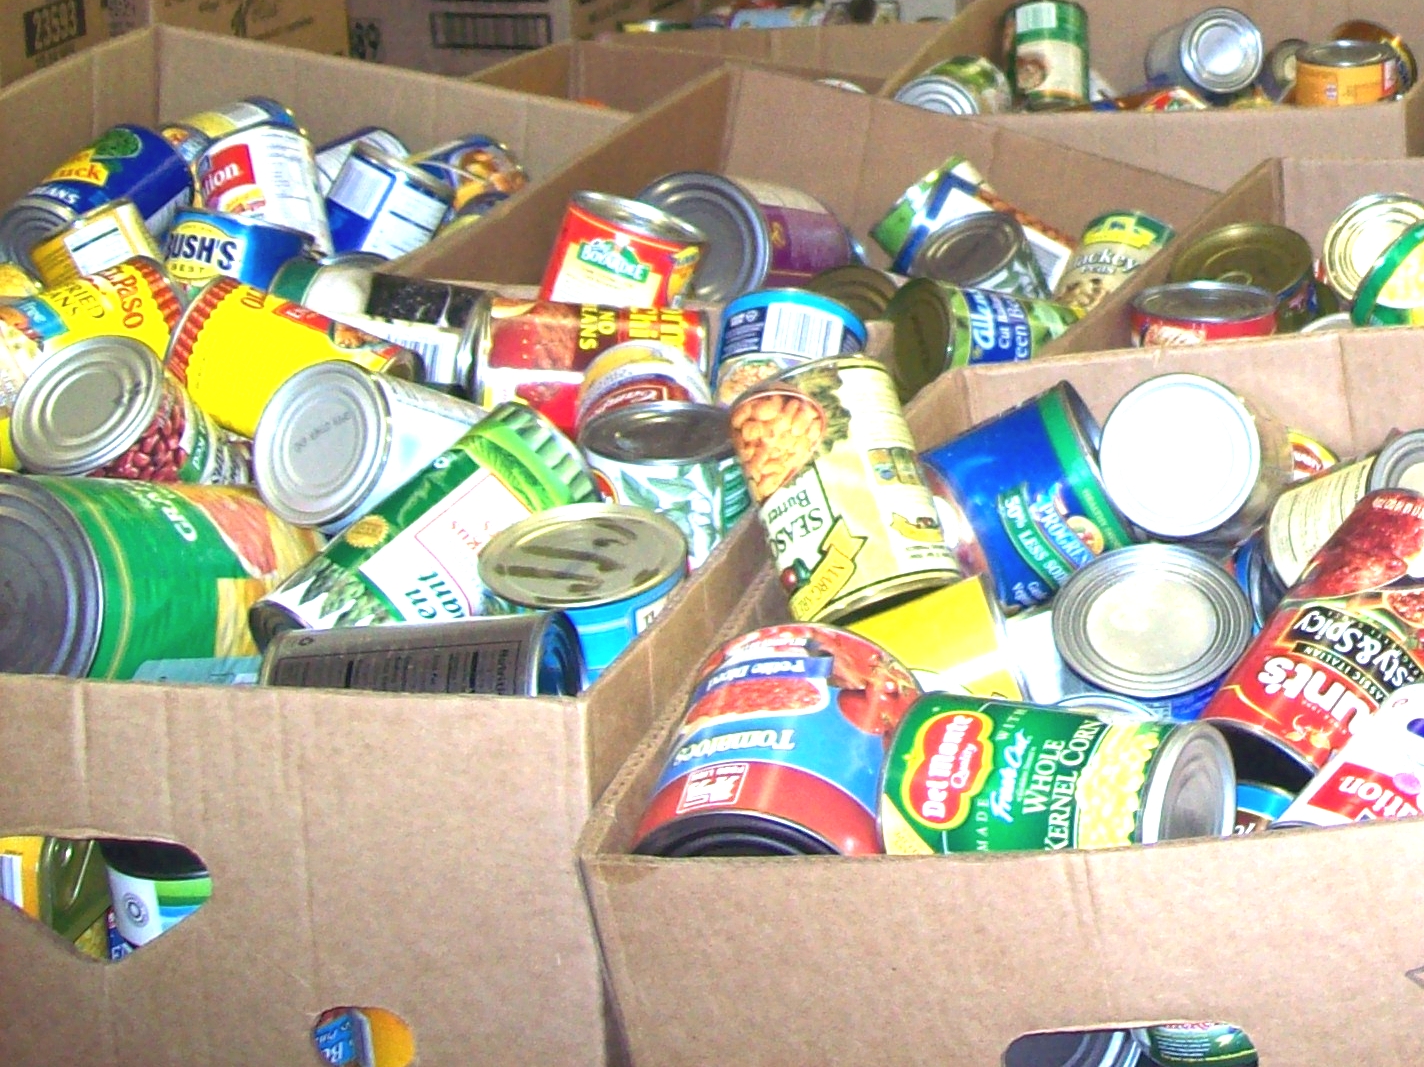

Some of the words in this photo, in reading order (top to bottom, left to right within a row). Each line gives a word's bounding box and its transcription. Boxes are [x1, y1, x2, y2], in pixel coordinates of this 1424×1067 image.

[169, 262, 206, 274] BEST
[597, 311, 617, 337] NO
[1018, 529, 1048, 562] LESS
[1303, 645, 1353, 680] ITALIAN
[672, 728, 797, 767] Tomatoes
[927, 714, 974, 778] Monte
[1058, 719, 1102, 767] CORN
[950, 742, 978, 789] Quality
[975, 798, 990, 851] MADE
[995, 708, 1029, 742] WITH
[1021, 738, 1066, 815] WHOLE
[921, 780, 949, 819] Del
[1044, 770, 1080, 851] KERNEL
